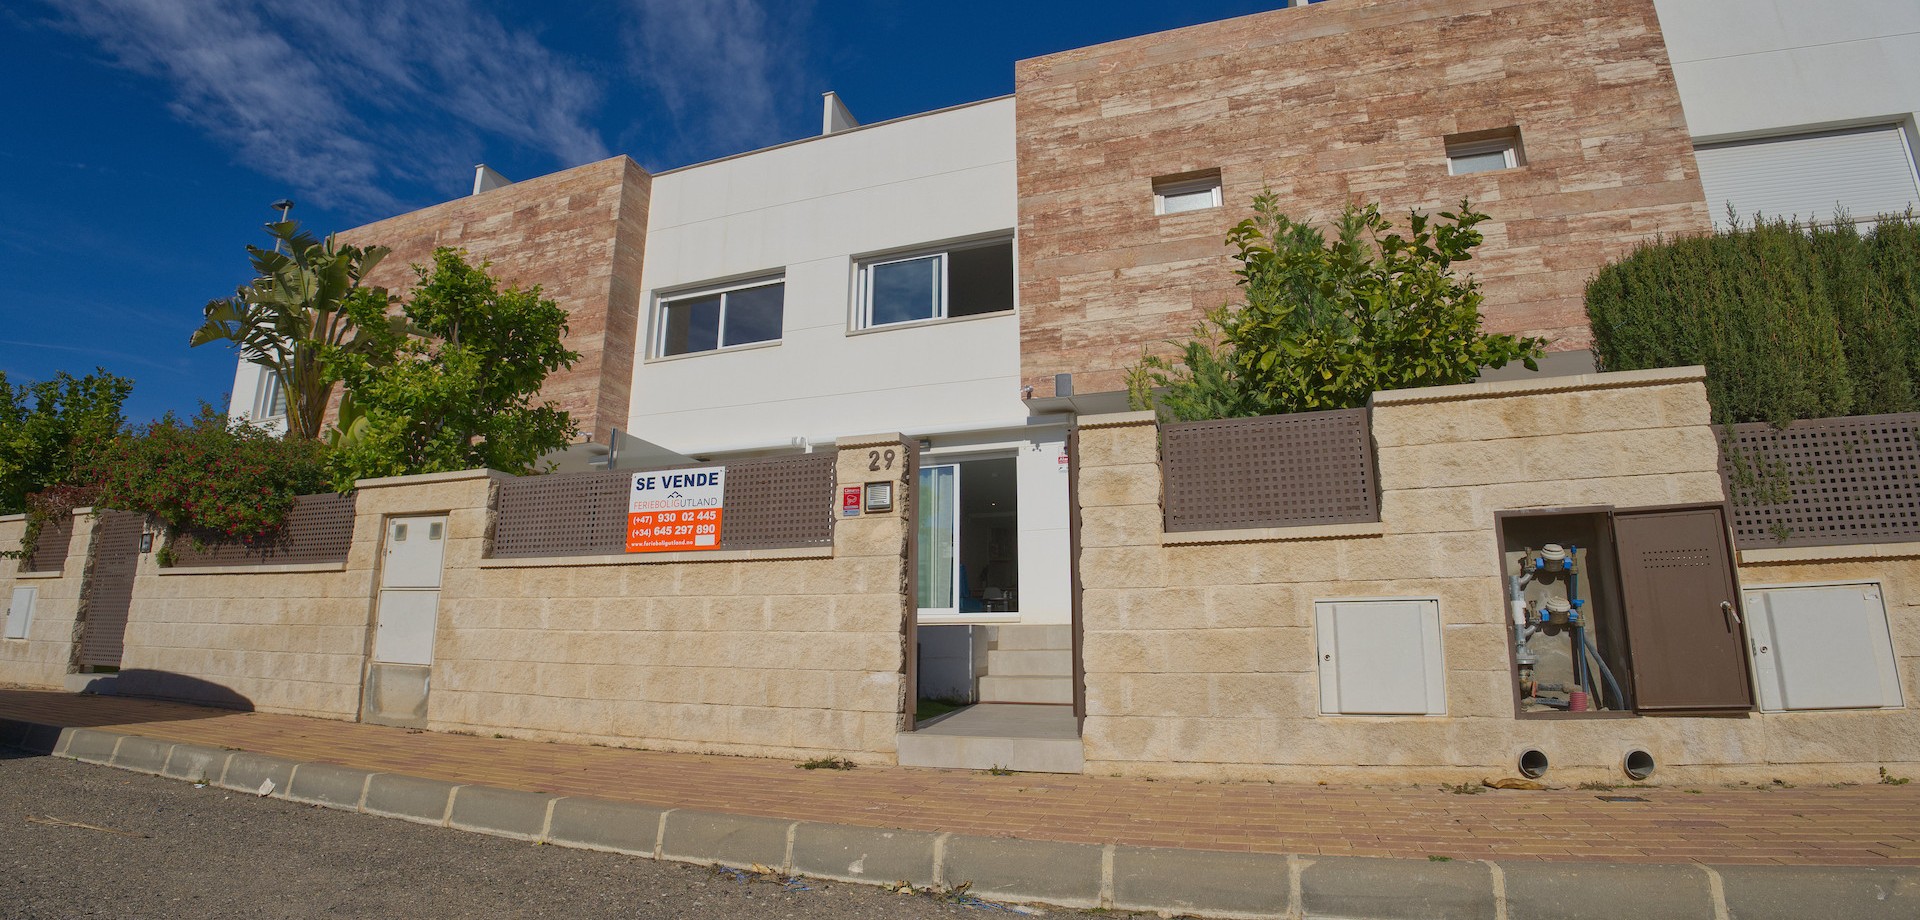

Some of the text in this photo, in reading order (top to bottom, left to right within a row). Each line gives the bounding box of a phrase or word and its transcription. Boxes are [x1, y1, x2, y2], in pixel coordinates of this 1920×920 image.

[868, 449, 895, 471] 29
[636, 472, 719, 491] SE VENDE
[633, 497, 718, 510] FERIEBOLIGUTLAND
[633, 510, 716, 525] (+47) 930 02 445
[632, 524, 715, 538] (+34) 645 297 890
